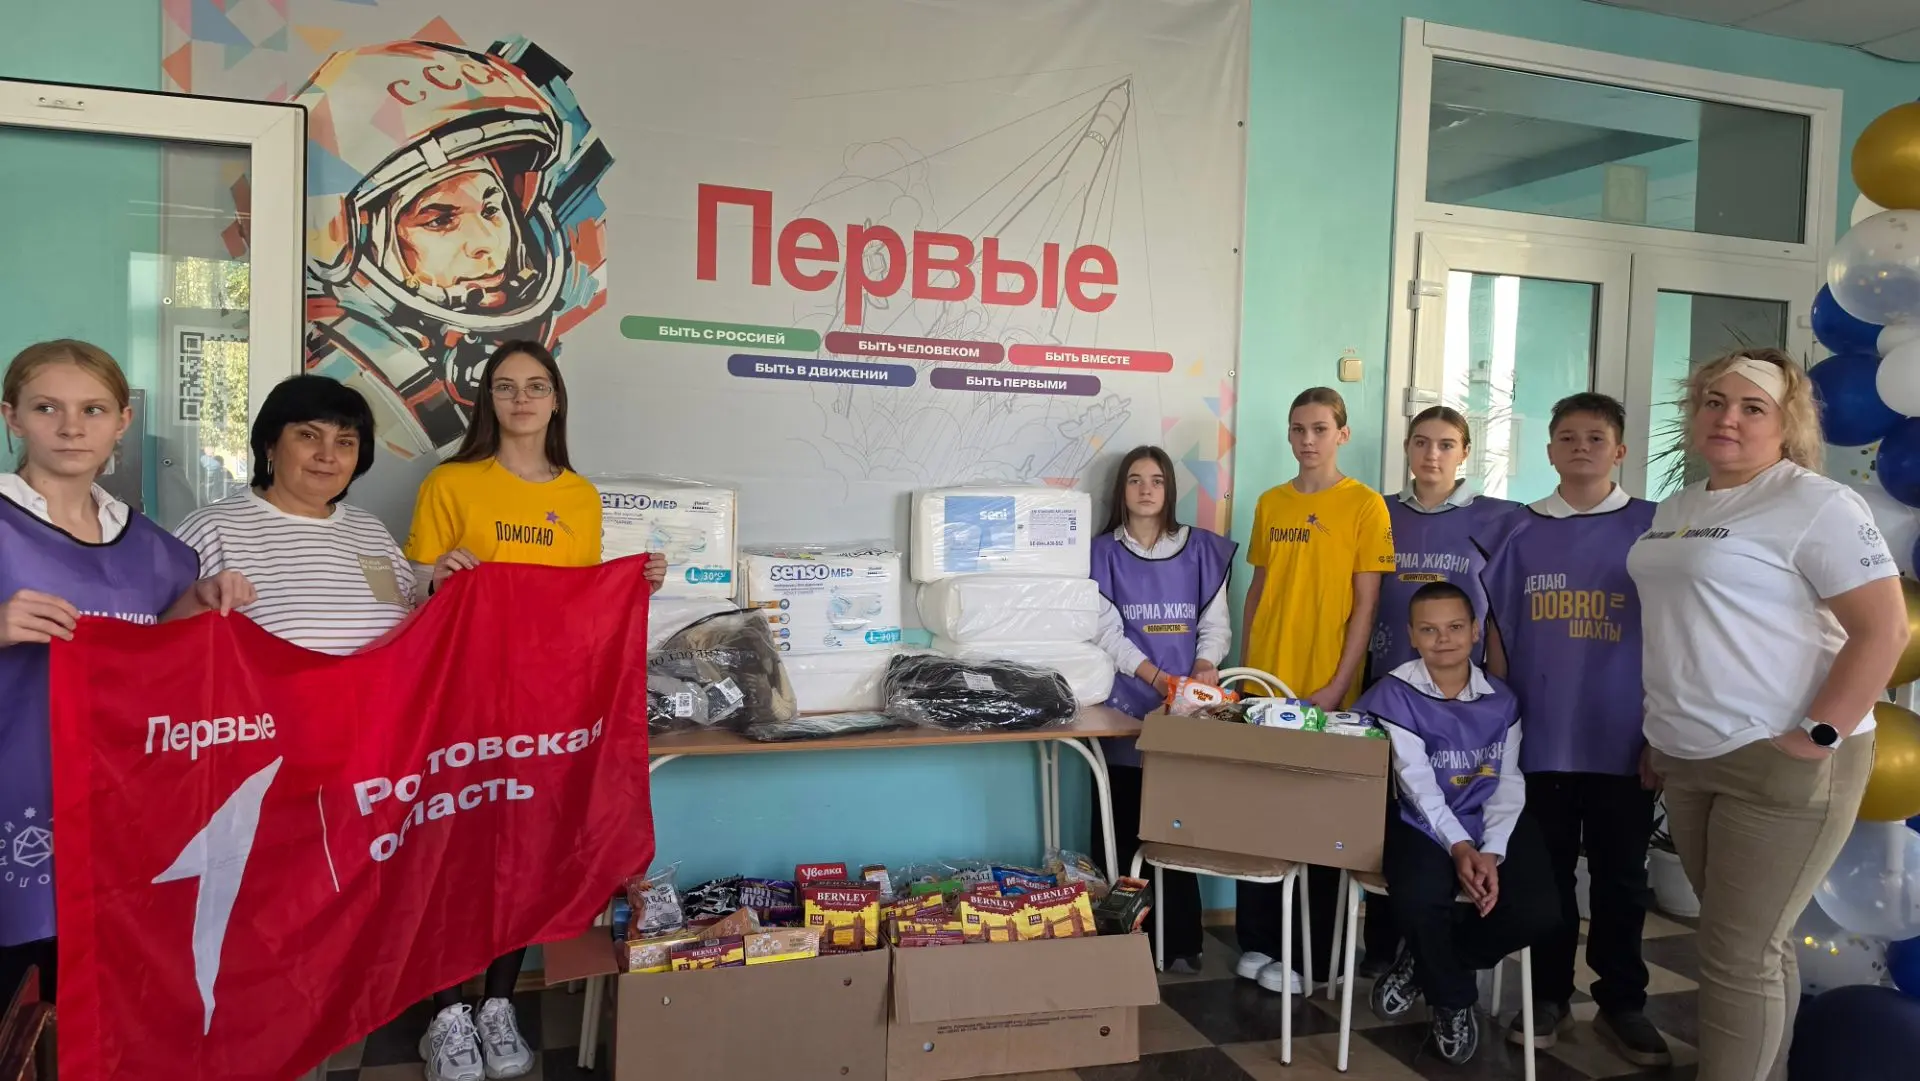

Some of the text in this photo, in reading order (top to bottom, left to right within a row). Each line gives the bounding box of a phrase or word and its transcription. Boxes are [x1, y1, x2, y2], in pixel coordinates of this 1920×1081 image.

[697, 183, 1119, 326] Первые
[659, 326, 785, 345] БЫТЬ С РОССИЕЙ
[858, 341, 980, 358] БЫТЬ ЧЕЛОВЕКОМ
[1045, 351, 1131, 365] БЫТЬ ВМЕСТЕ
[755, 362, 888, 380] БЫТЬ В ДВИЖЕНИИ
[966, 376, 1067, 390] БЫТЬ ПЕРВЫМИ
[600, 493, 677, 510] enso MED
[1395, 552, 1469, 574] РМА ЖИЗНИ
[770, 564, 829, 581] senso
[831, 568, 853, 578] MED
[1524, 573, 1566, 595] ДЕЛАЮ
[1123, 603, 1161, 620] НОРМА
[1569, 619, 1622, 642] ШАХТЫ
[145, 713, 276, 761] Первые
[1470, 742, 1504, 768] ЖИЗН
[353, 717, 603, 816] Ротовская
[369, 778, 534, 862] оласть
[801, 867, 842, 880] Увелка
[817, 892, 868, 902] BERNLEY
[970, 896, 1015, 908] BERNLEY
[1030, 886, 1076, 902] BERNLEY
[692, 947, 723, 957] BERNLEY
